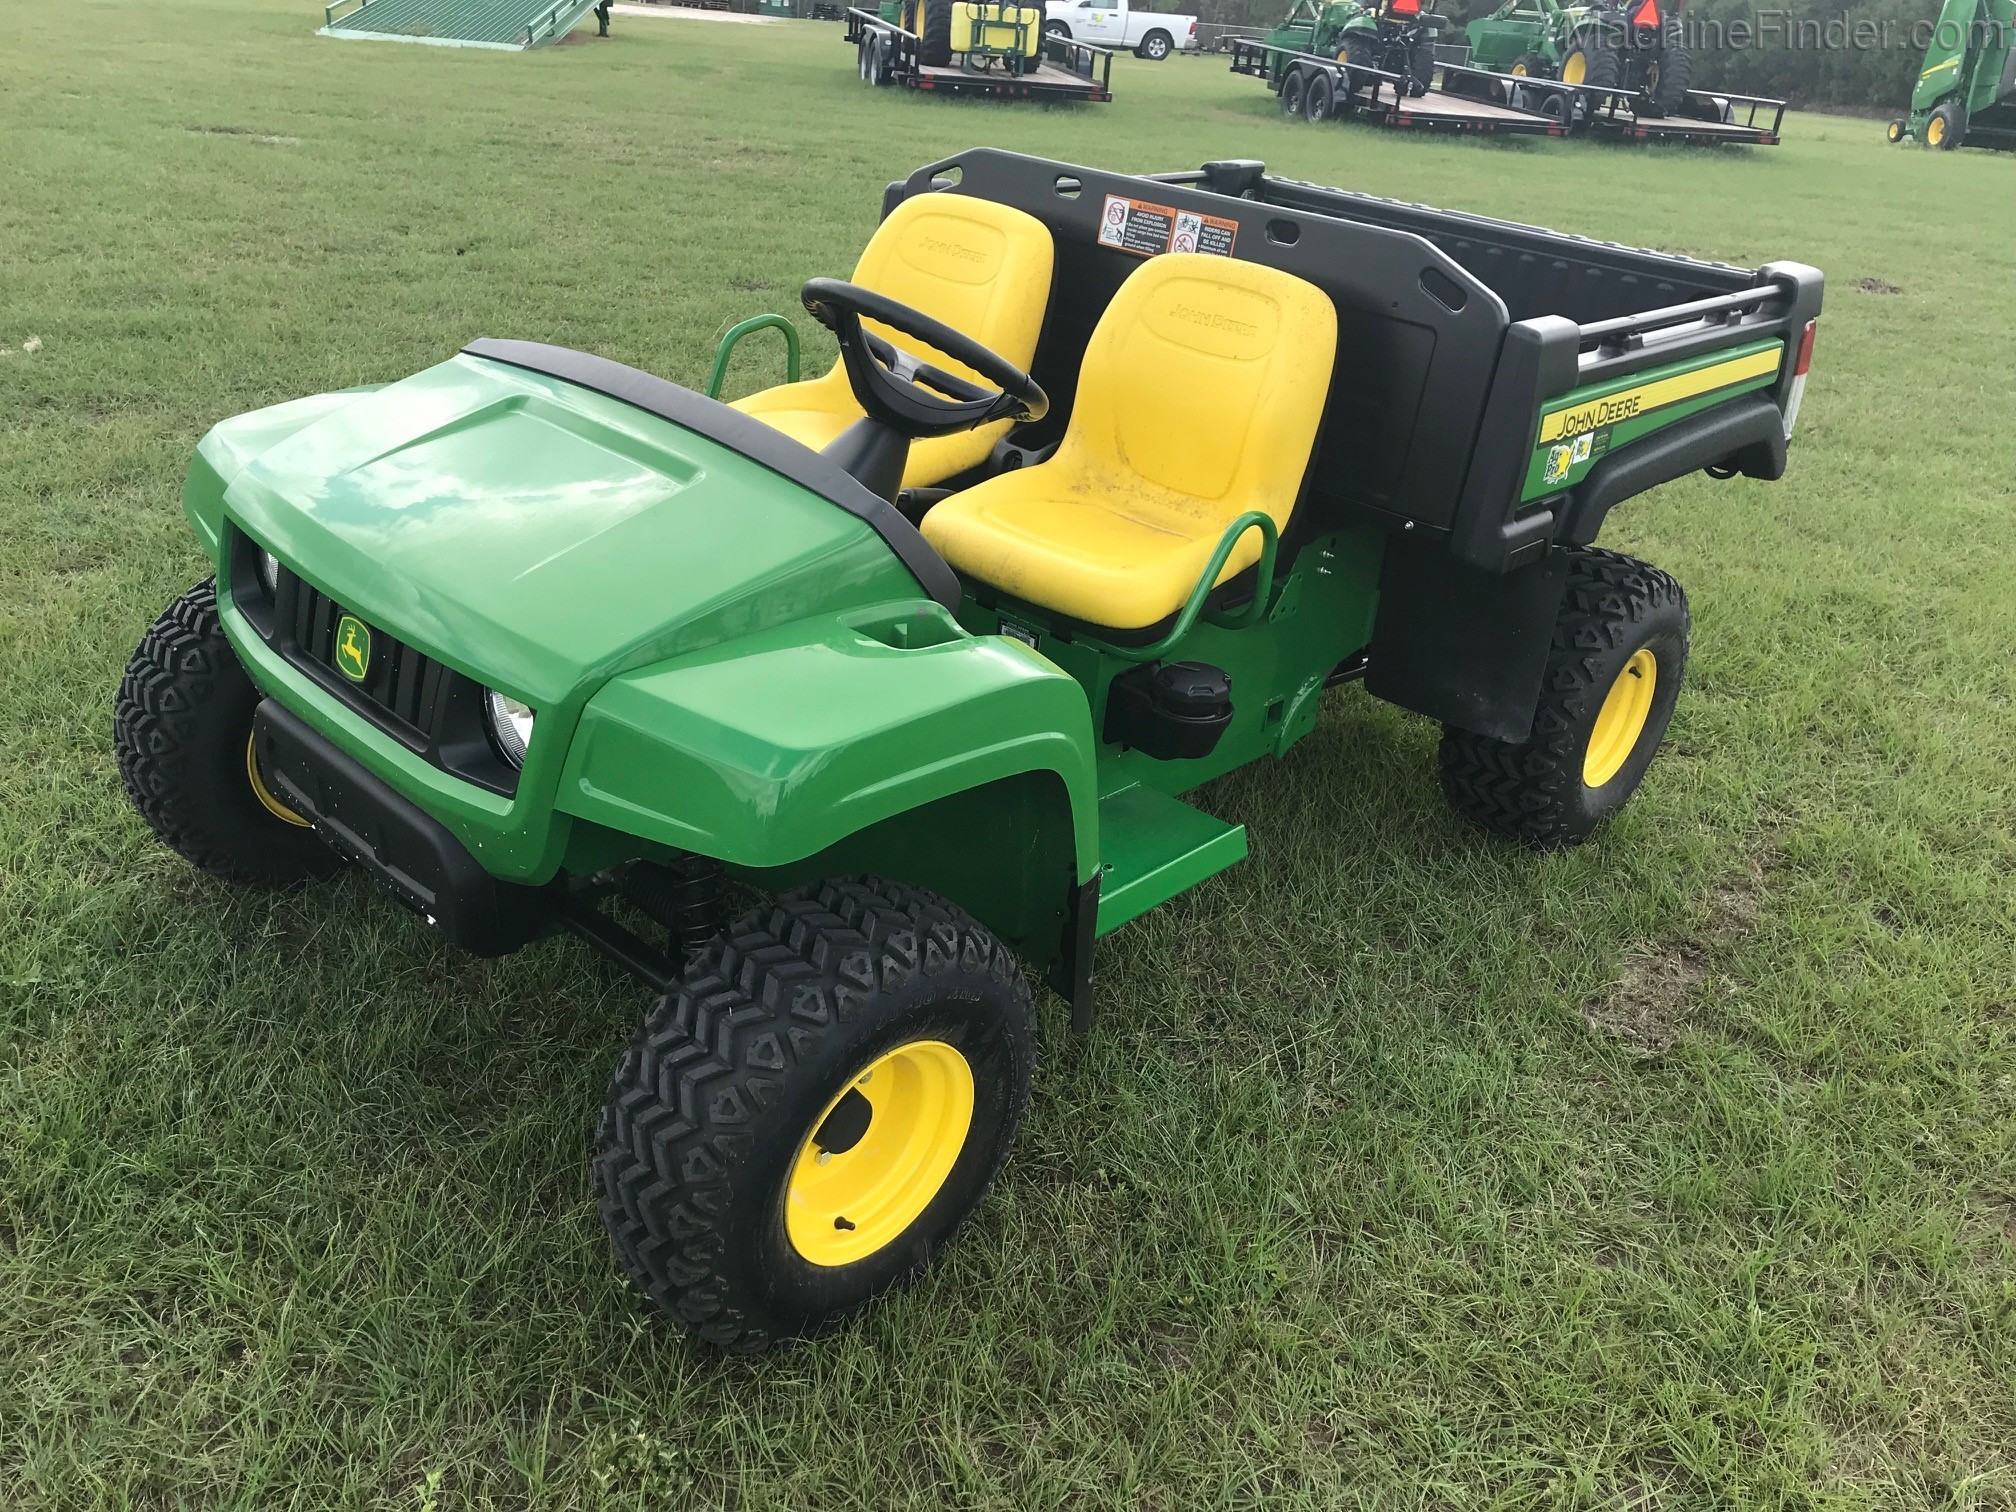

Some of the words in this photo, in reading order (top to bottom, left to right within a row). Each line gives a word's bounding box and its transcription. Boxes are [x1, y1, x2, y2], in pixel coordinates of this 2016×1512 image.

[1143, 203, 1168, 215] WARNING
[1136, 211, 1149, 219] AVOID
[1149, 214, 1165, 222] INJURY
[1143, 218, 1167, 229] EXPLOSION
[1209, 219, 1237, 229] WARNING
[1204, 226, 1221, 235] RIDERS
[1556, 408, 1596, 438] JOHN
[1598, 395, 1641, 424] DEERE
